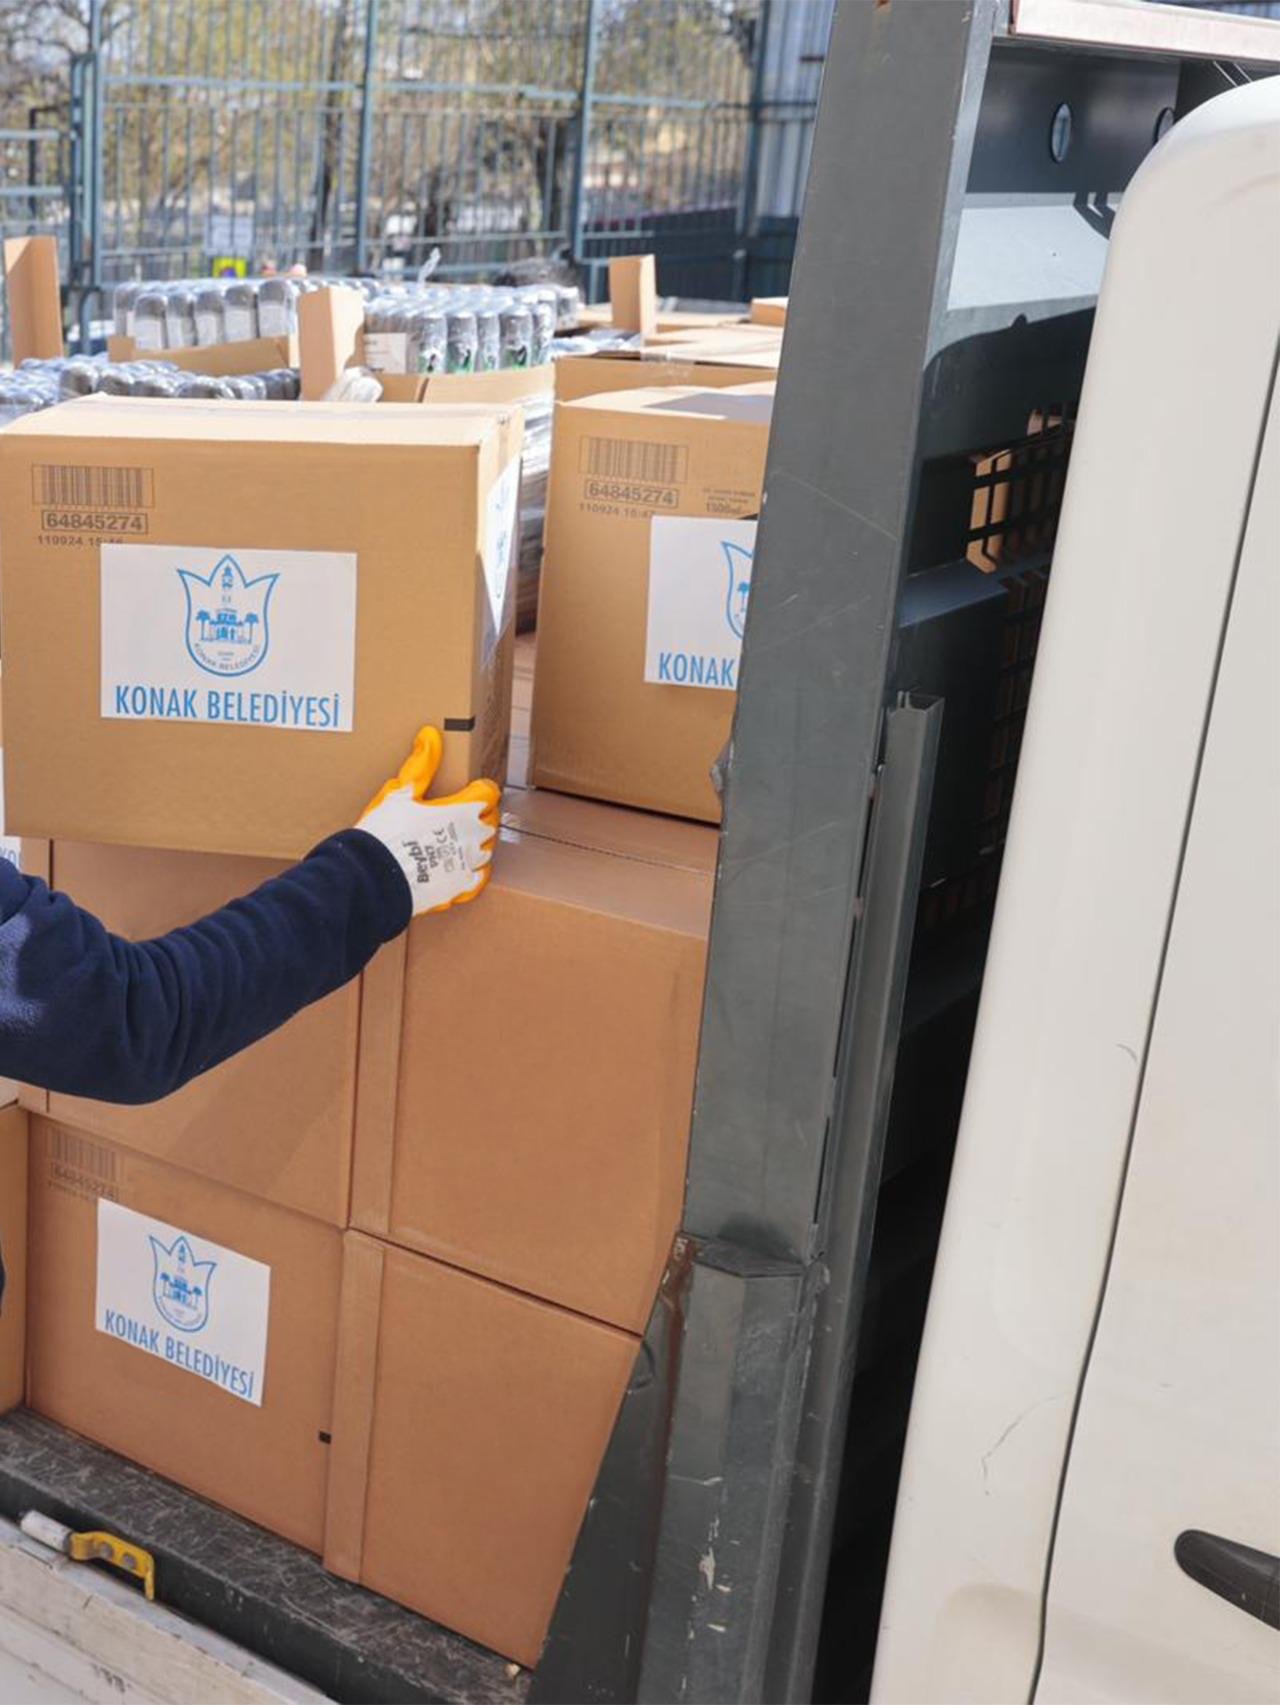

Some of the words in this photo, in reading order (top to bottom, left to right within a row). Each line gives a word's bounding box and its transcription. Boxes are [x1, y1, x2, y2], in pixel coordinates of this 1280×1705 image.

[589, 482, 674, 506] 64845274
[46, 512, 143, 531] 64845274
[658, 652, 735, 687] KONAK
[115, 685, 198, 718] KONAK
[207, 689, 340, 728] BELEDİYESİ
[105, 1309, 160, 1354] KONAK
[166, 1335, 256, 1399] BELEDİYESİ
